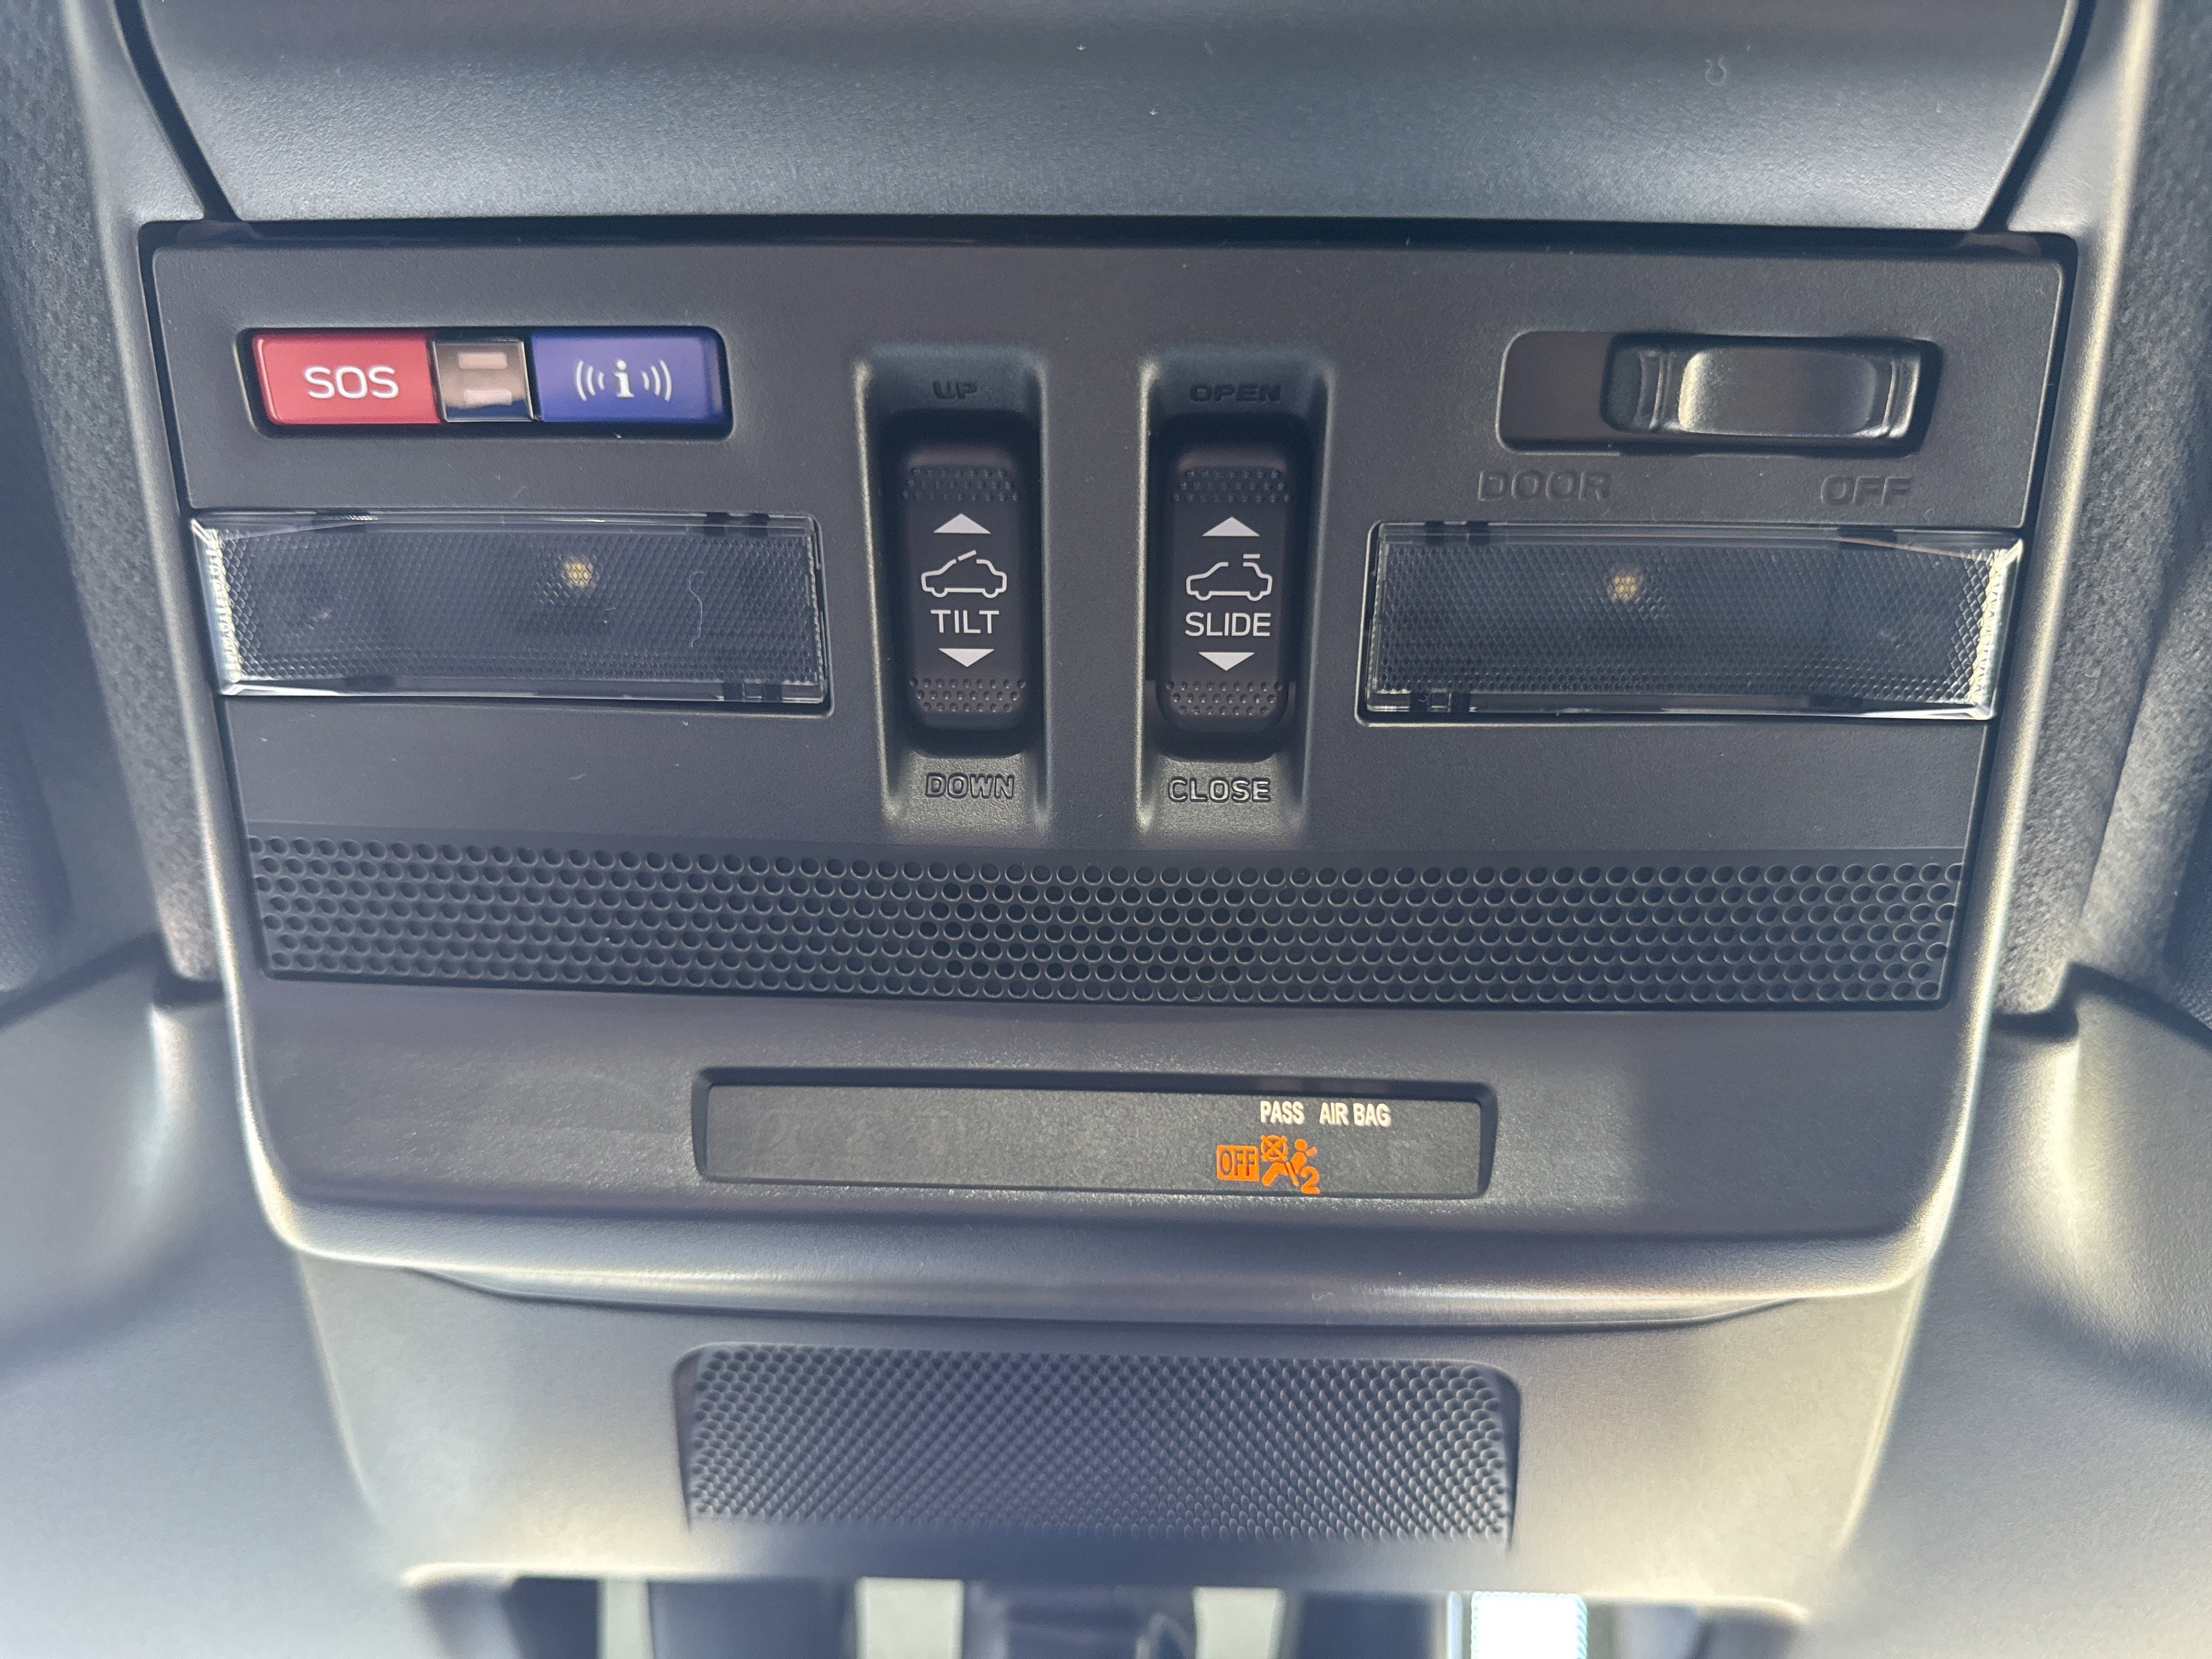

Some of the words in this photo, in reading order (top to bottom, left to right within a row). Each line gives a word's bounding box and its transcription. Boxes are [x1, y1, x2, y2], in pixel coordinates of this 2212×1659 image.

[304, 365, 399, 399] SOS
[933, 380, 978, 399] UP
[1189, 383, 1282, 402] OPEN
[1477, 470, 1612, 503] DOOR
[1820, 475, 1912, 507] OFF
[930, 610, 1000, 634] TILT
[1184, 612, 1271, 637] SLIDE
[925, 773, 1015, 800] DOWN
[1167, 777, 1271, 804] CLOSE
[1260, 1101, 1305, 1125] PASS
[1319, 1102, 1350, 1126] AIR
[1352, 1103, 1392, 1127] BAG
[1220, 1148, 1257, 1177] OFF
